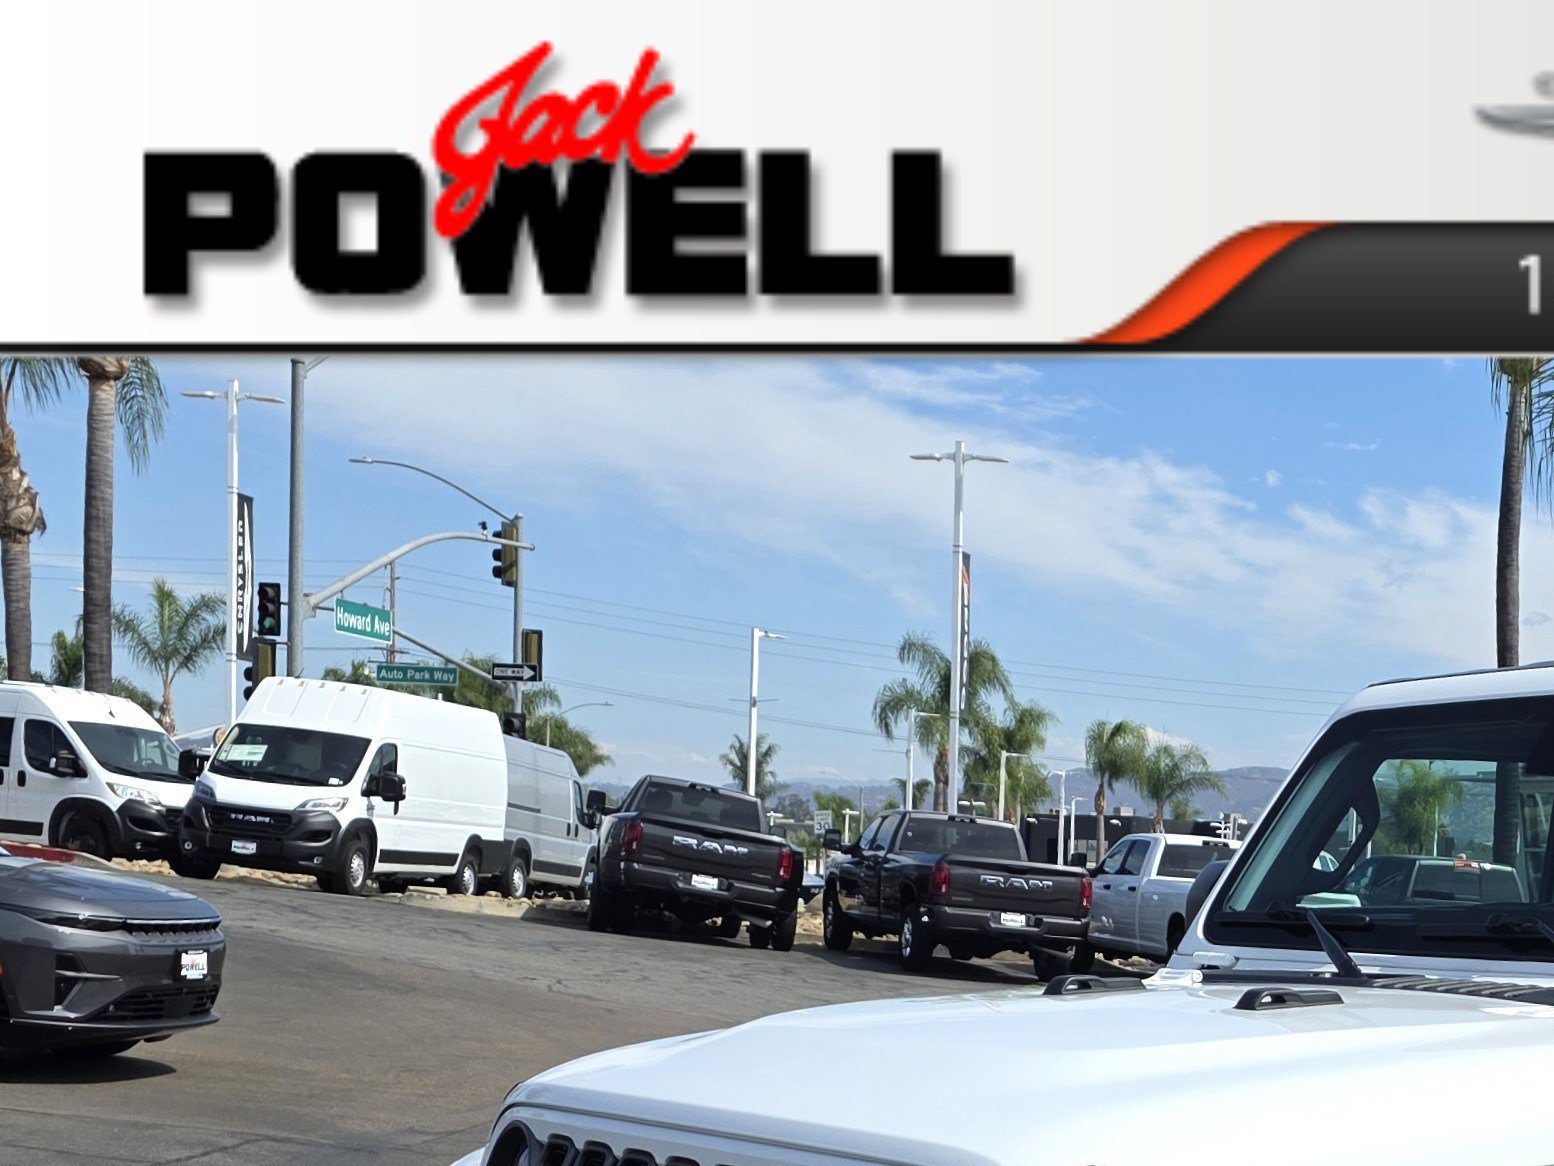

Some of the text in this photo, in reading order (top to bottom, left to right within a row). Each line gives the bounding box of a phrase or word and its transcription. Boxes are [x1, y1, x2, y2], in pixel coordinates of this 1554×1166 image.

[336, 605, 391, 637] Howard Ave
[379, 667, 456, 683] Auto Park Way
[816, 821, 830, 831] 30
[673, 835, 749, 856] RAM
[980, 874, 1053, 892] RAM
